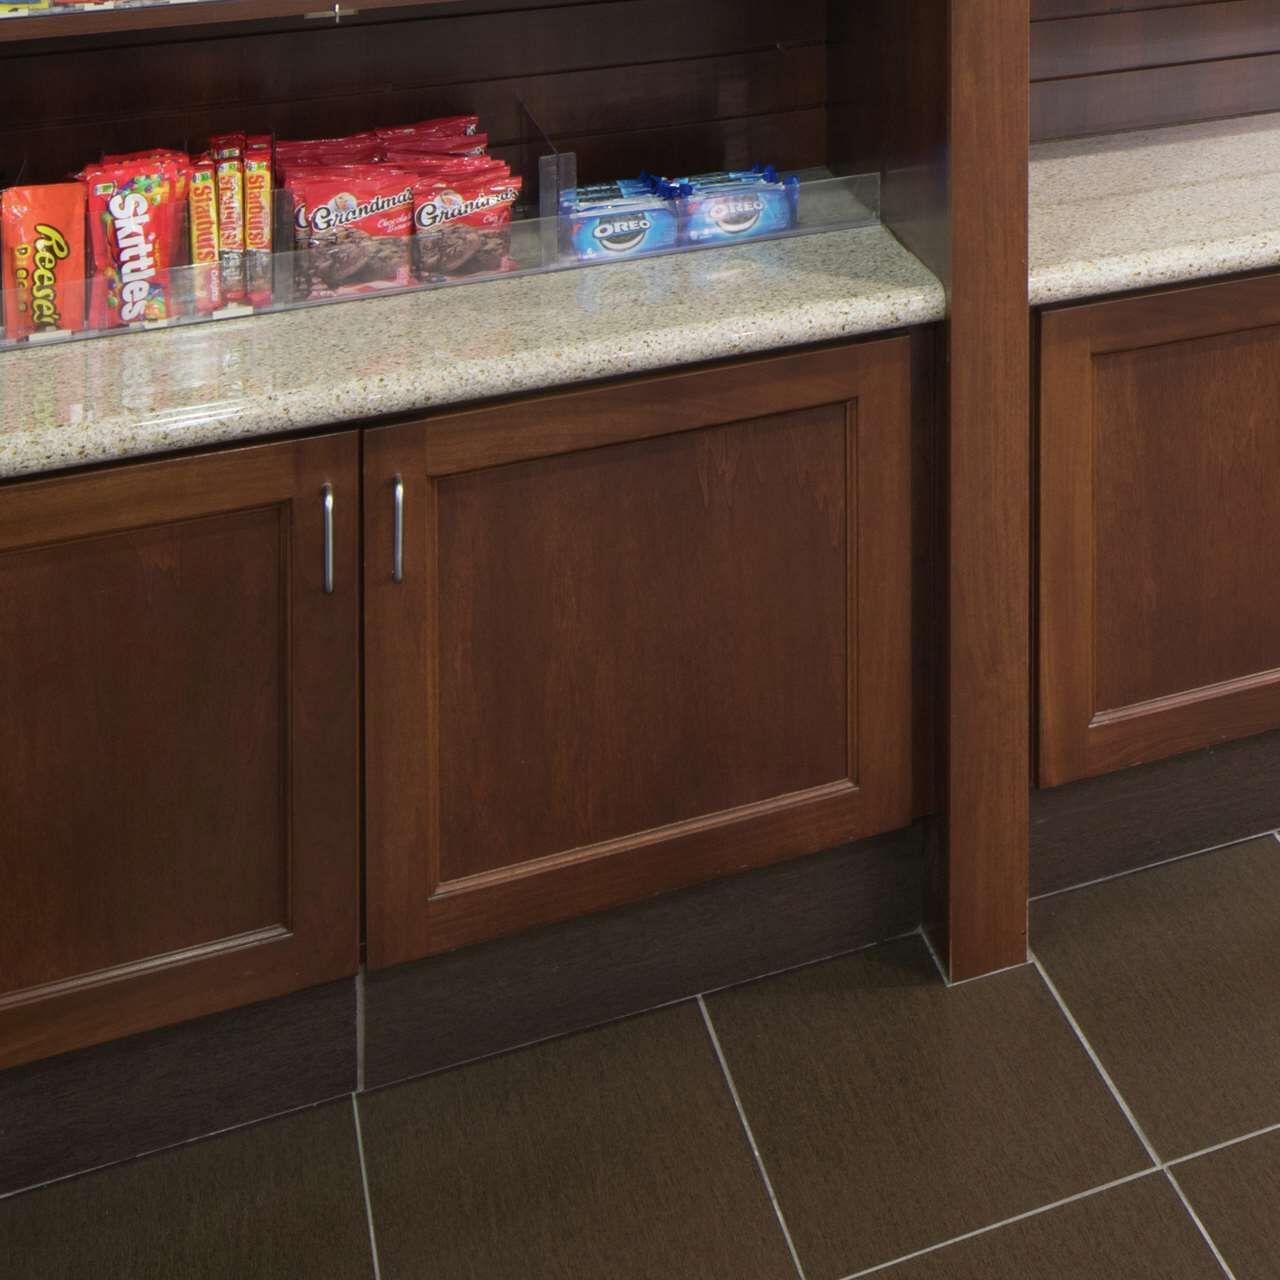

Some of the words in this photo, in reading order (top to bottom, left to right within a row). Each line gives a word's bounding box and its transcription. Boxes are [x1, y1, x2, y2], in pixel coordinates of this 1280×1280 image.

[592, 218, 651, 238] OREO
[708, 200, 765, 218] OREO
[33, 224, 69, 325] Reese's
[108, 193, 156, 320] Skittles
